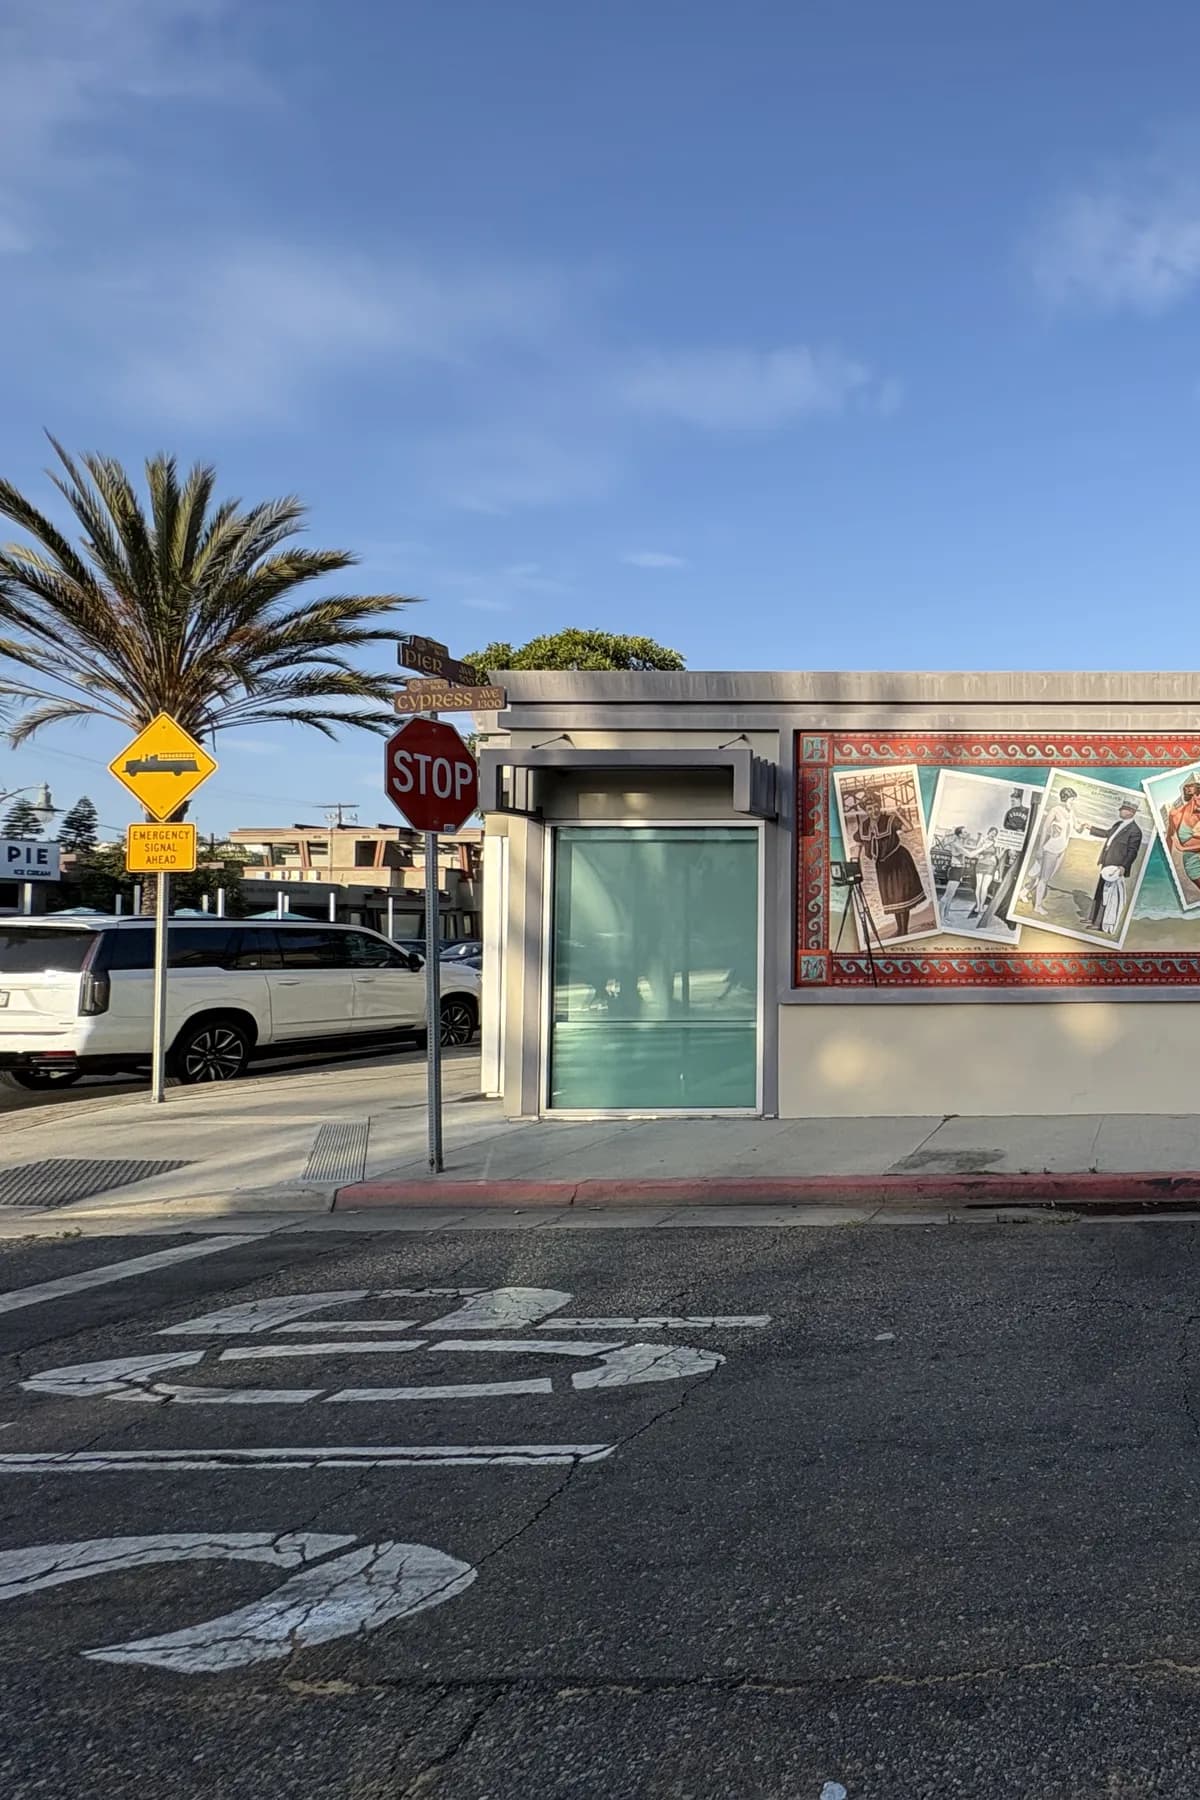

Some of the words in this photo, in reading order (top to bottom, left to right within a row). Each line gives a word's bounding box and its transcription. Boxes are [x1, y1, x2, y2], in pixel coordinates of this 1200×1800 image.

[404, 648, 443, 674] PIER
[479, 689, 500, 699] AVE
[397, 692, 473, 711] CYPRESS
[477, 699, 502, 709] 1300
[392, 750, 473, 801] STOP
[133, 830, 190, 840] EMERGENCY
[144, 842, 177, 852] SIGNAL
[7, 846, 49, 864] PIE
[145, 855, 177, 865] AHEAD
